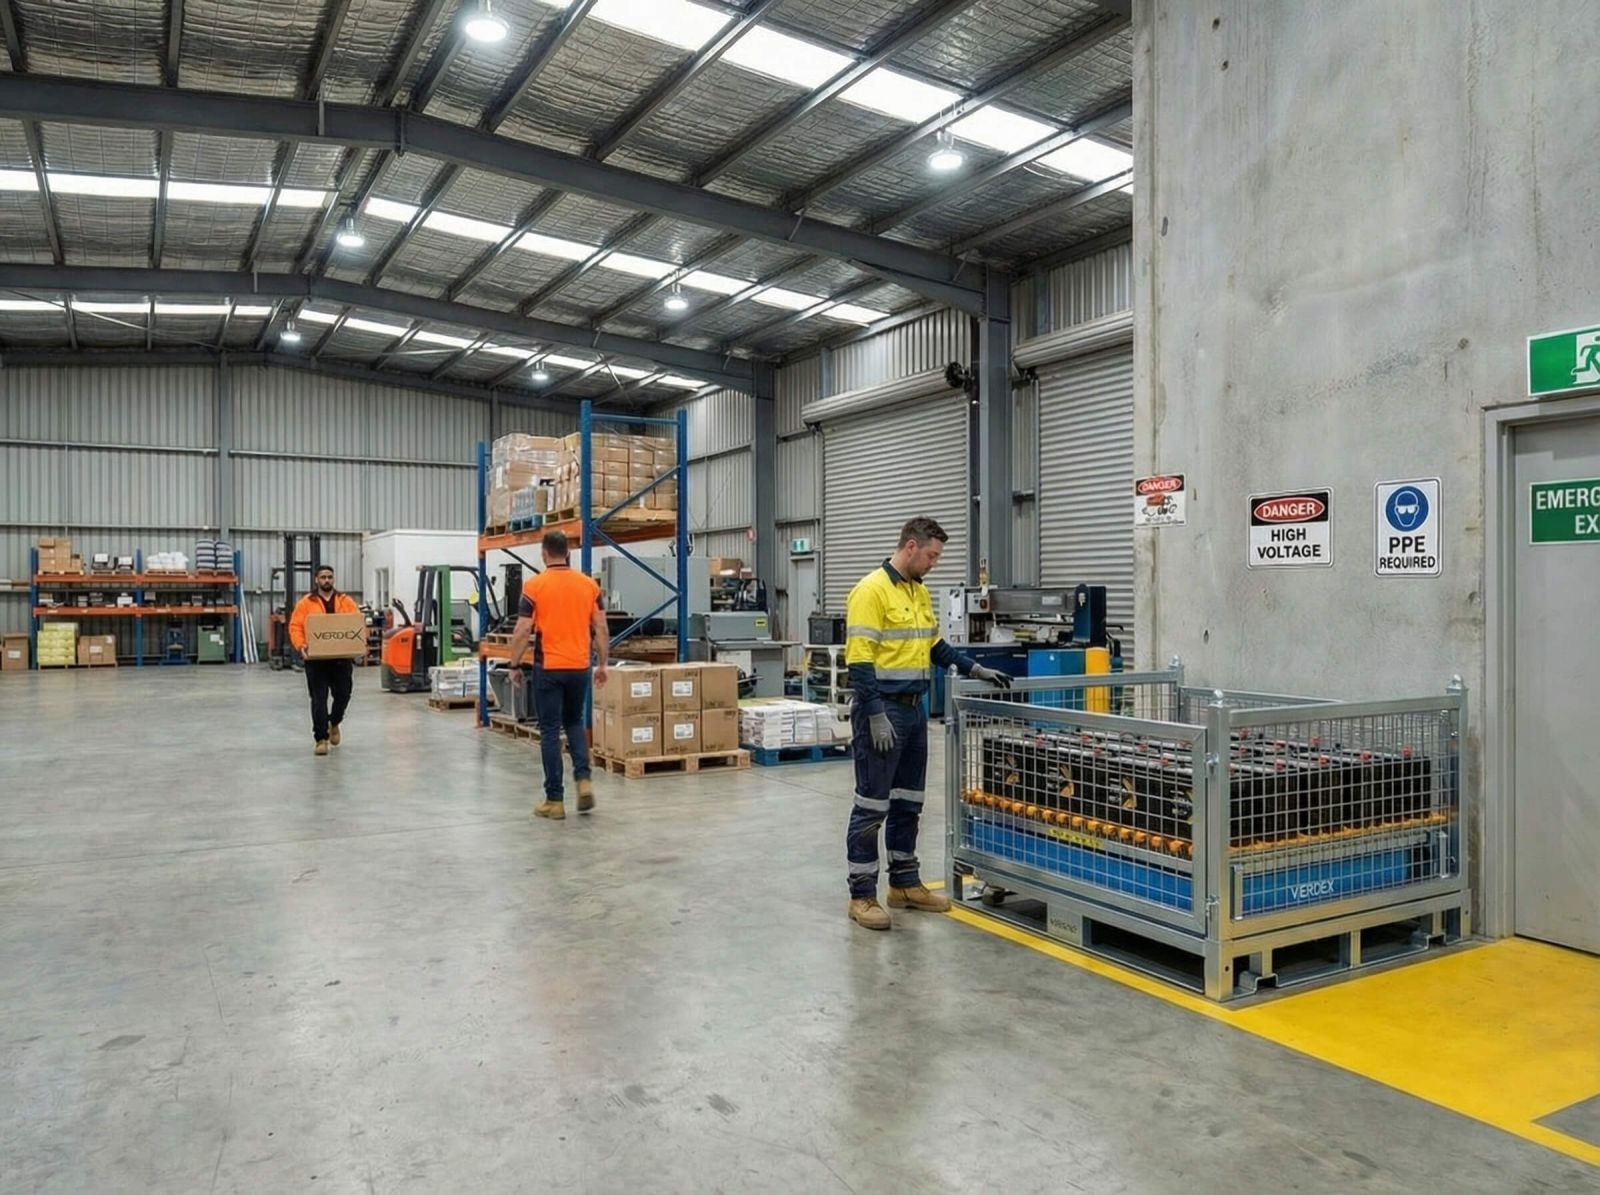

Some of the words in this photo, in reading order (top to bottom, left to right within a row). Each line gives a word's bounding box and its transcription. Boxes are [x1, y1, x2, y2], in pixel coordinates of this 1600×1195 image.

[1536, 486, 1600, 510] EMERG
[1262, 501, 1316, 518] DANGER
[1271, 528, 1306, 542] HIGH
[1257, 544, 1321, 559] VOLTAGE
[1389, 535, 1425, 554] PPE
[1379, 555, 1436, 569] REQUIRED
[1291, 879, 1335, 900] VERDEX
